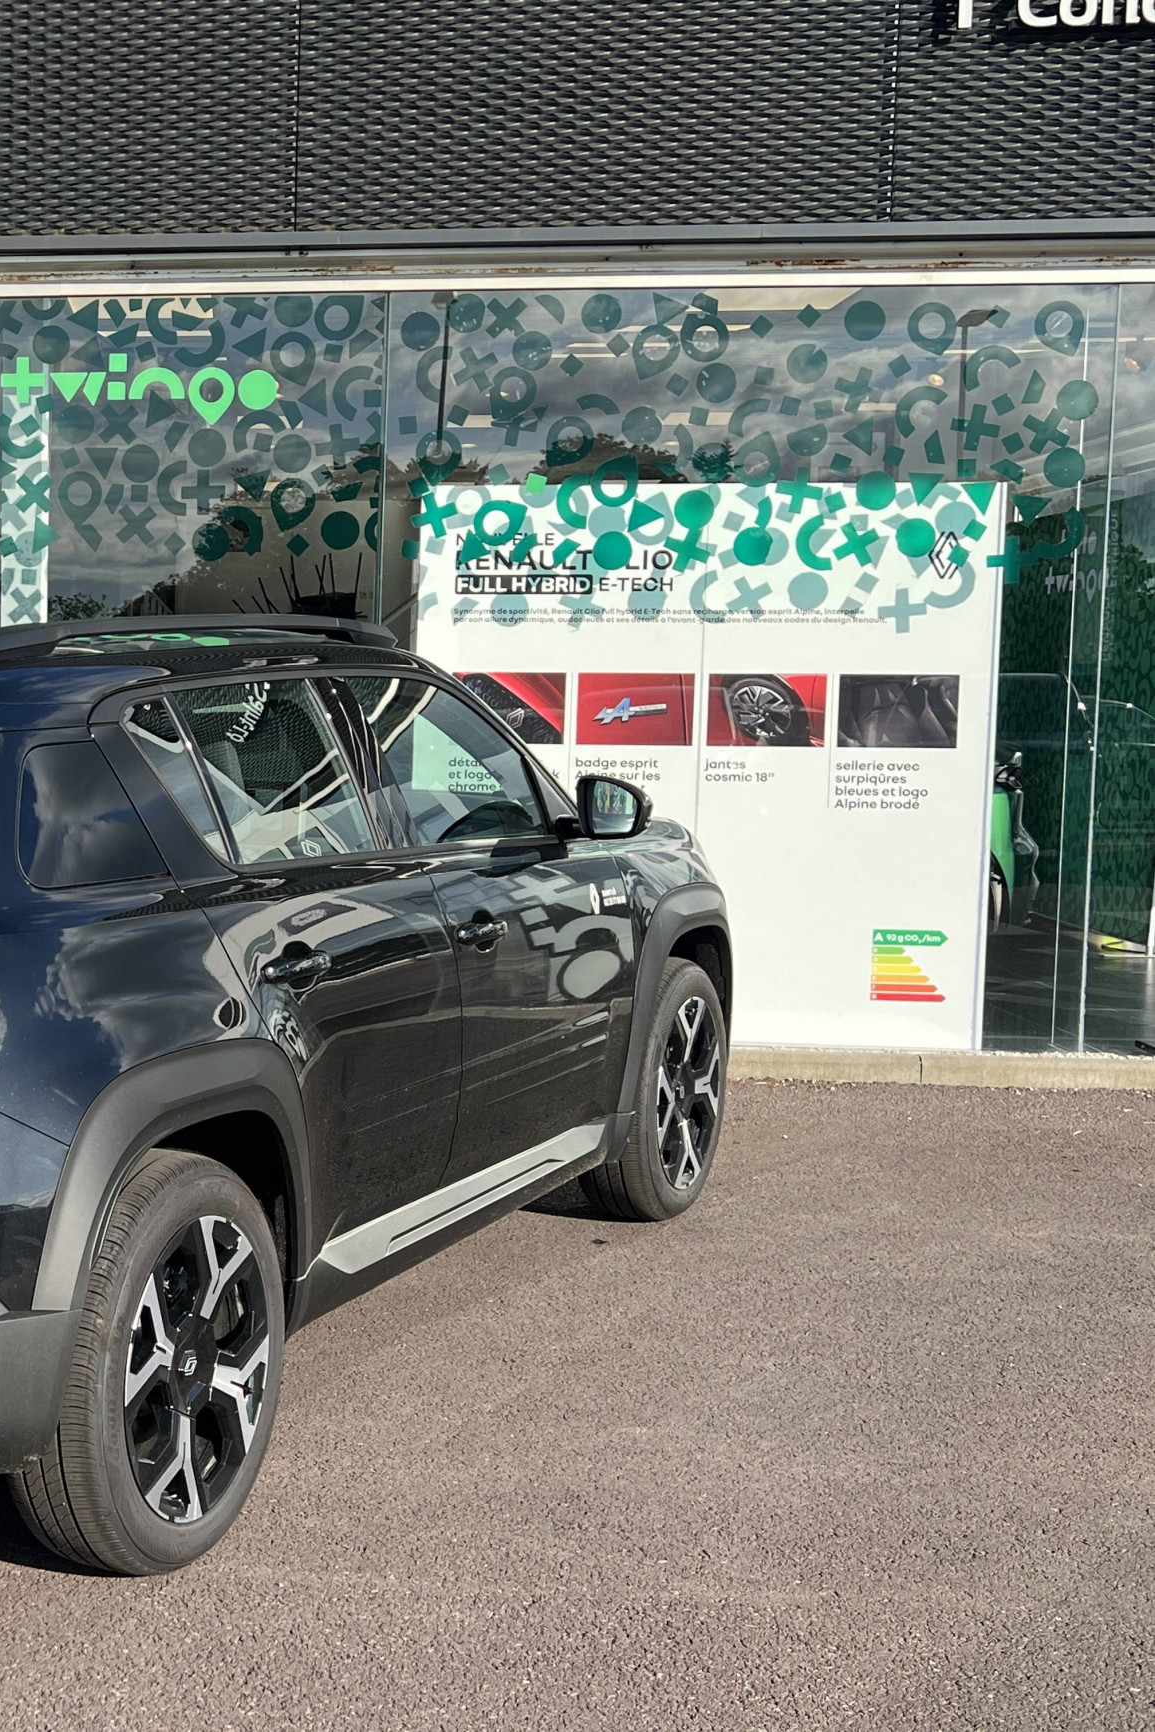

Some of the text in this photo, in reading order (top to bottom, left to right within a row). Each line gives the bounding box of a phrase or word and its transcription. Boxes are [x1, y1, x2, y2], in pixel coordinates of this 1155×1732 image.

[625, 549, 673, 570] LIO
[457, 576, 674, 593] FULL HYBRID E-TECH
[616, 608, 643, 617] hybrid
[575, 757, 659, 772] badge esprit
[835, 760, 920, 772] sellerie avec
[448, 769, 492, 781] et logo
[619, 772, 639, 780] sur
[642, 770, 661, 781] les
[704, 772, 753, 782] cosmic
[835, 773, 907, 785] surpiqûres
[448, 781, 497, 791] chrome
[835, 786, 929, 800] bleues et logo
[834, 798, 920, 810] Alpine brodé
[874, 932, 884, 942] A
